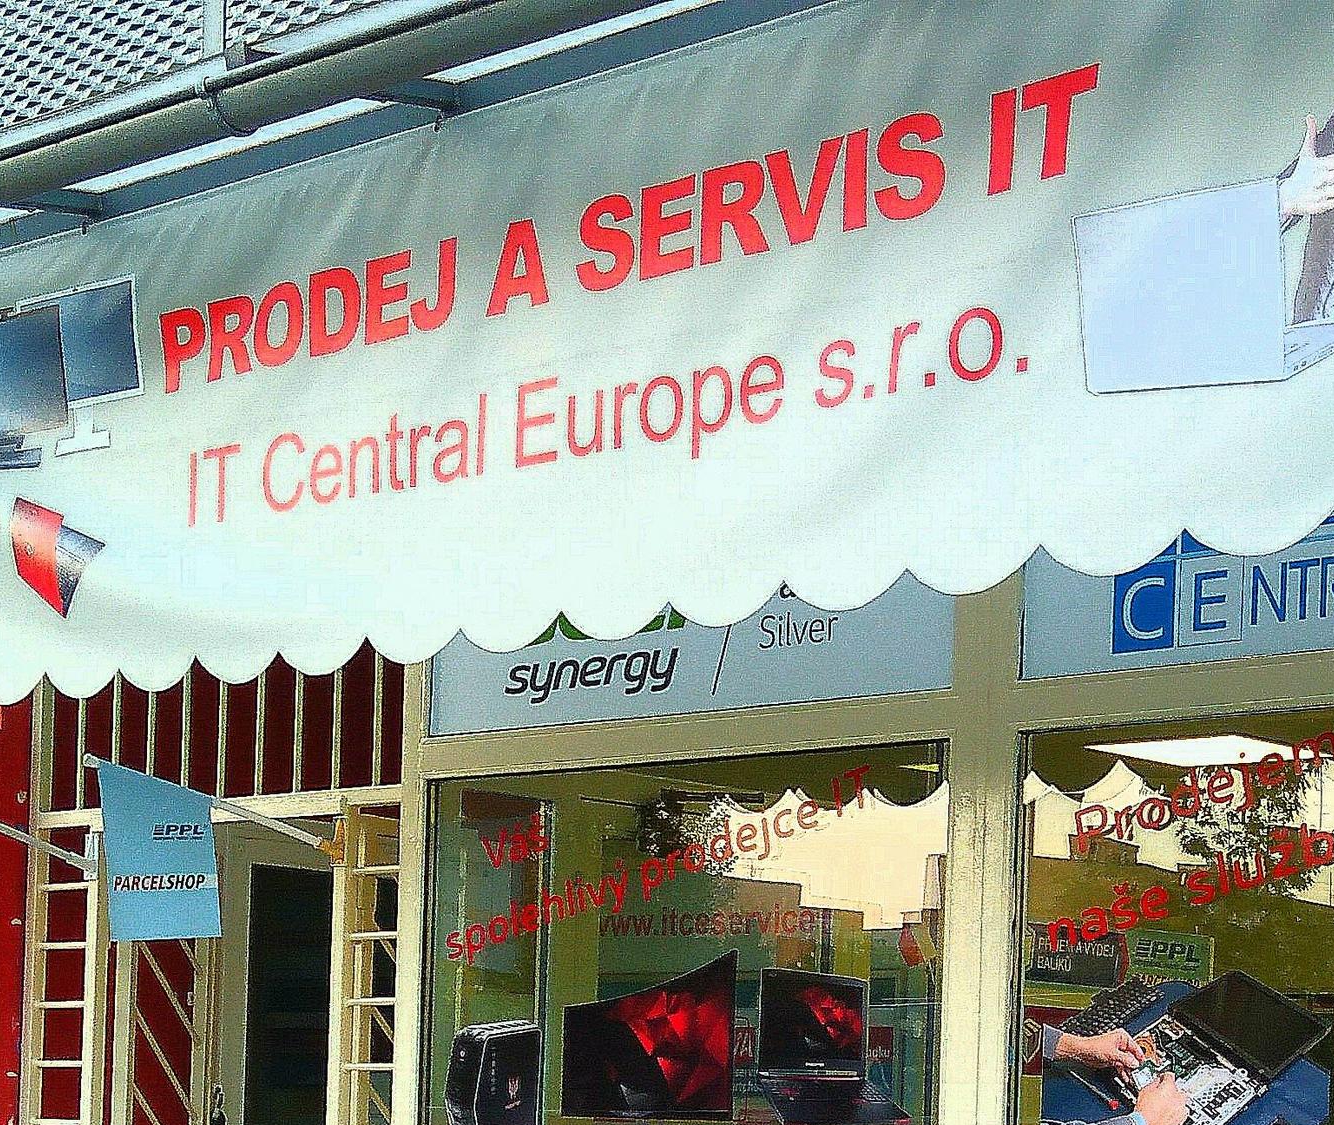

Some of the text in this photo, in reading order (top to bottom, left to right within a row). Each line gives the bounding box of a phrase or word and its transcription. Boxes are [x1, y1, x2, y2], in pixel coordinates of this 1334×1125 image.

[160, 63, 1100, 395] PRODEJ A SERVIS IT
[187, 305, 1031, 528] IT Central Europe s.r.o.
[758, 611, 839, 649] Silver
[504, 646, 679, 704] synergy
[164, 824, 205, 836] PPL
[482, 816, 550, 870] Váš
[113, 874, 206, 892] PARCELSHOP
[446, 764, 870, 966] spolehlivý prodejce IT
[1046, 876, 1168, 953] naše
[1037, 954, 1072, 972] BALÍKŮ
[1084, 940, 1115, 957] VÝDEJ
